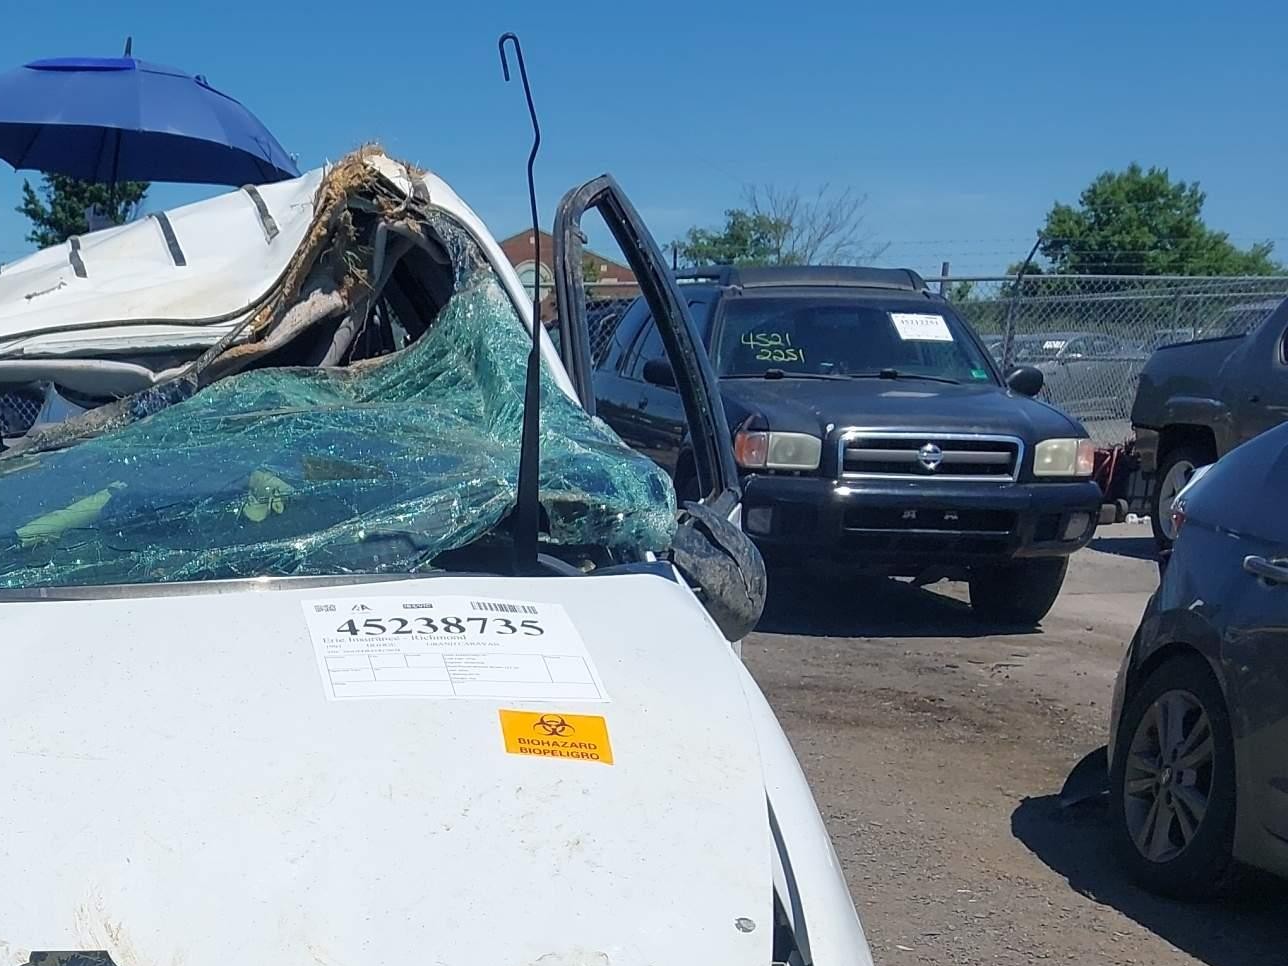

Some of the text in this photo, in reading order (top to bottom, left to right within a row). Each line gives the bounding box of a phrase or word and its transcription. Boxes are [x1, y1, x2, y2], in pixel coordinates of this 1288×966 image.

[741, 332, 792, 349] 4521
[756, 348, 805, 364] 2251
[336, 616, 545, 637] 45238735
[517, 737, 598, 751] BIOHAZARD
[519, 746, 601, 761] BIOPELIGRO
